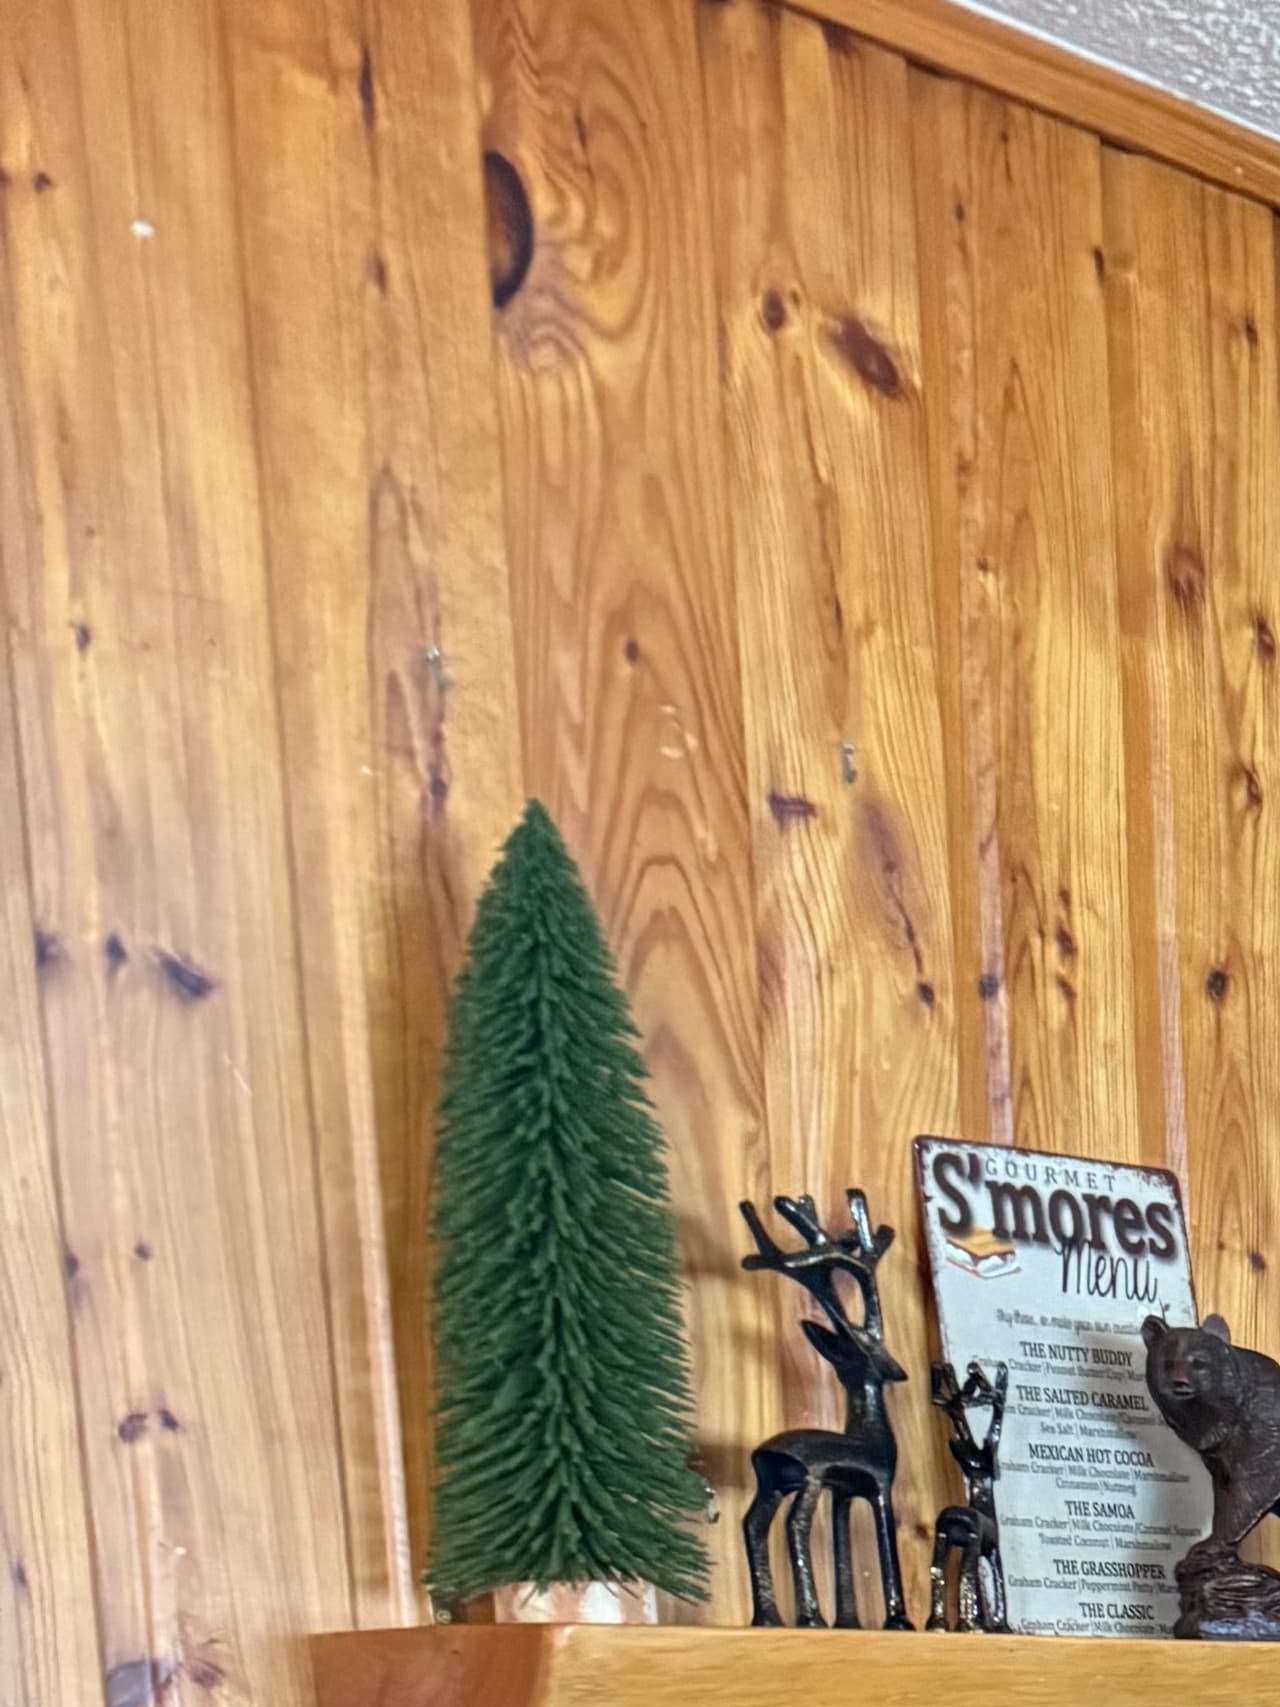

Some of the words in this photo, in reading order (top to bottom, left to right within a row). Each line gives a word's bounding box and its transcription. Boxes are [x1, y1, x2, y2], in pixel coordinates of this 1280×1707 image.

[985, 1159, 1115, 1192] GOURMET
[933, 1152, 1177, 1258] S'mores
[1053, 1237, 1158, 1303] Menu
[1019, 1341, 1048, 1358] THE
[1048, 1344, 1090, 1363] NUTTY
[1092, 1349, 1133, 1367] BUDDY
[1016, 1385, 1042, 1401] THE
[1043, 1388, 1089, 1406] SALTED
[1092, 1393, 1149, 1411] CARAMEL
[1040, 1421, 1055, 1433] Sea
[1058, 1423, 1074, 1435] Salt
[1028, 1443, 1084, 1462] MEXICAN
[1086, 1449, 1111, 1465] HOT
[1114, 1450, 1155, 1467] COCOA
[1068, 1465, 1086, 1477] Milk
[1064, 1500, 1090, 1517] THE
[1093, 1503, 1136, 1519] SAMOA
[1071, 1519, 1091, 1532] Milk
[1053, 1559, 1079, 1575] THE
[1081, 1561, 1166, 1580] GRASSHOPPER
[1008, 1576, 1042, 1588] Graham
[1044, 1577, 1077, 1590] Cracker
[1078, 1603, 1104, 1618] THE
[1107, 1603, 1155, 1620] CLASSIC
